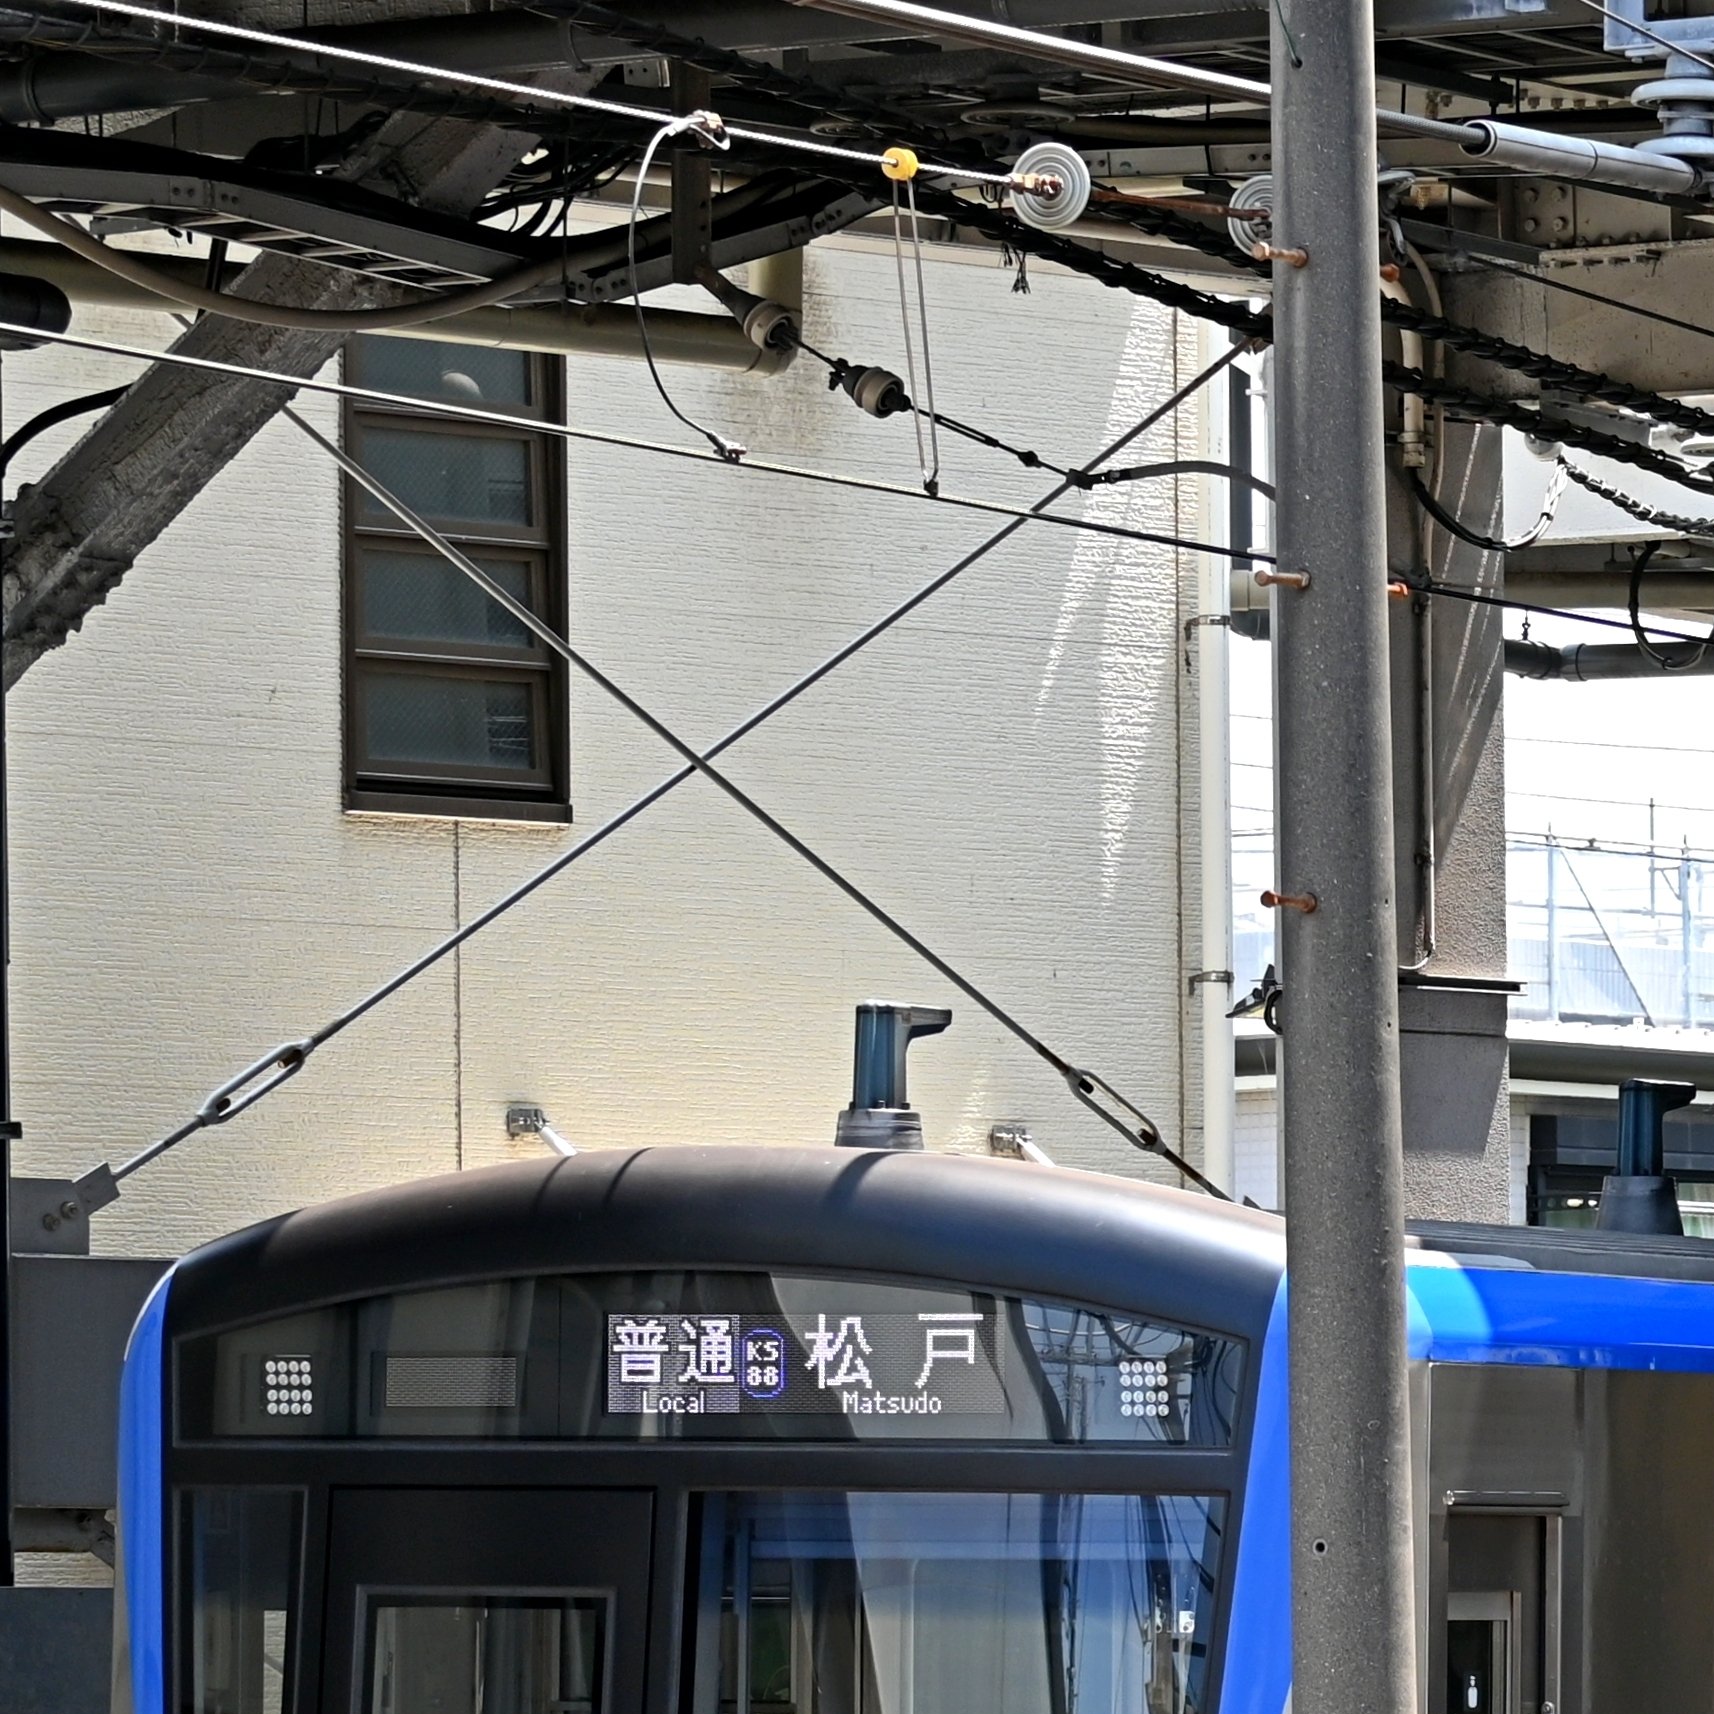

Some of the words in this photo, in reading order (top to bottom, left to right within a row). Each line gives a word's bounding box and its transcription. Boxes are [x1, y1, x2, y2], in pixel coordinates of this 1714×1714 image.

[611, 1318, 735, 1384] 普通
[804, 1313, 984, 1389] 松戸
[746, 1340, 779, 1362] KS
[746, 1366, 779, 1386] 88
[642, 1391, 706, 1414] Local
[842, 1391, 942, 1414] Matsudo
